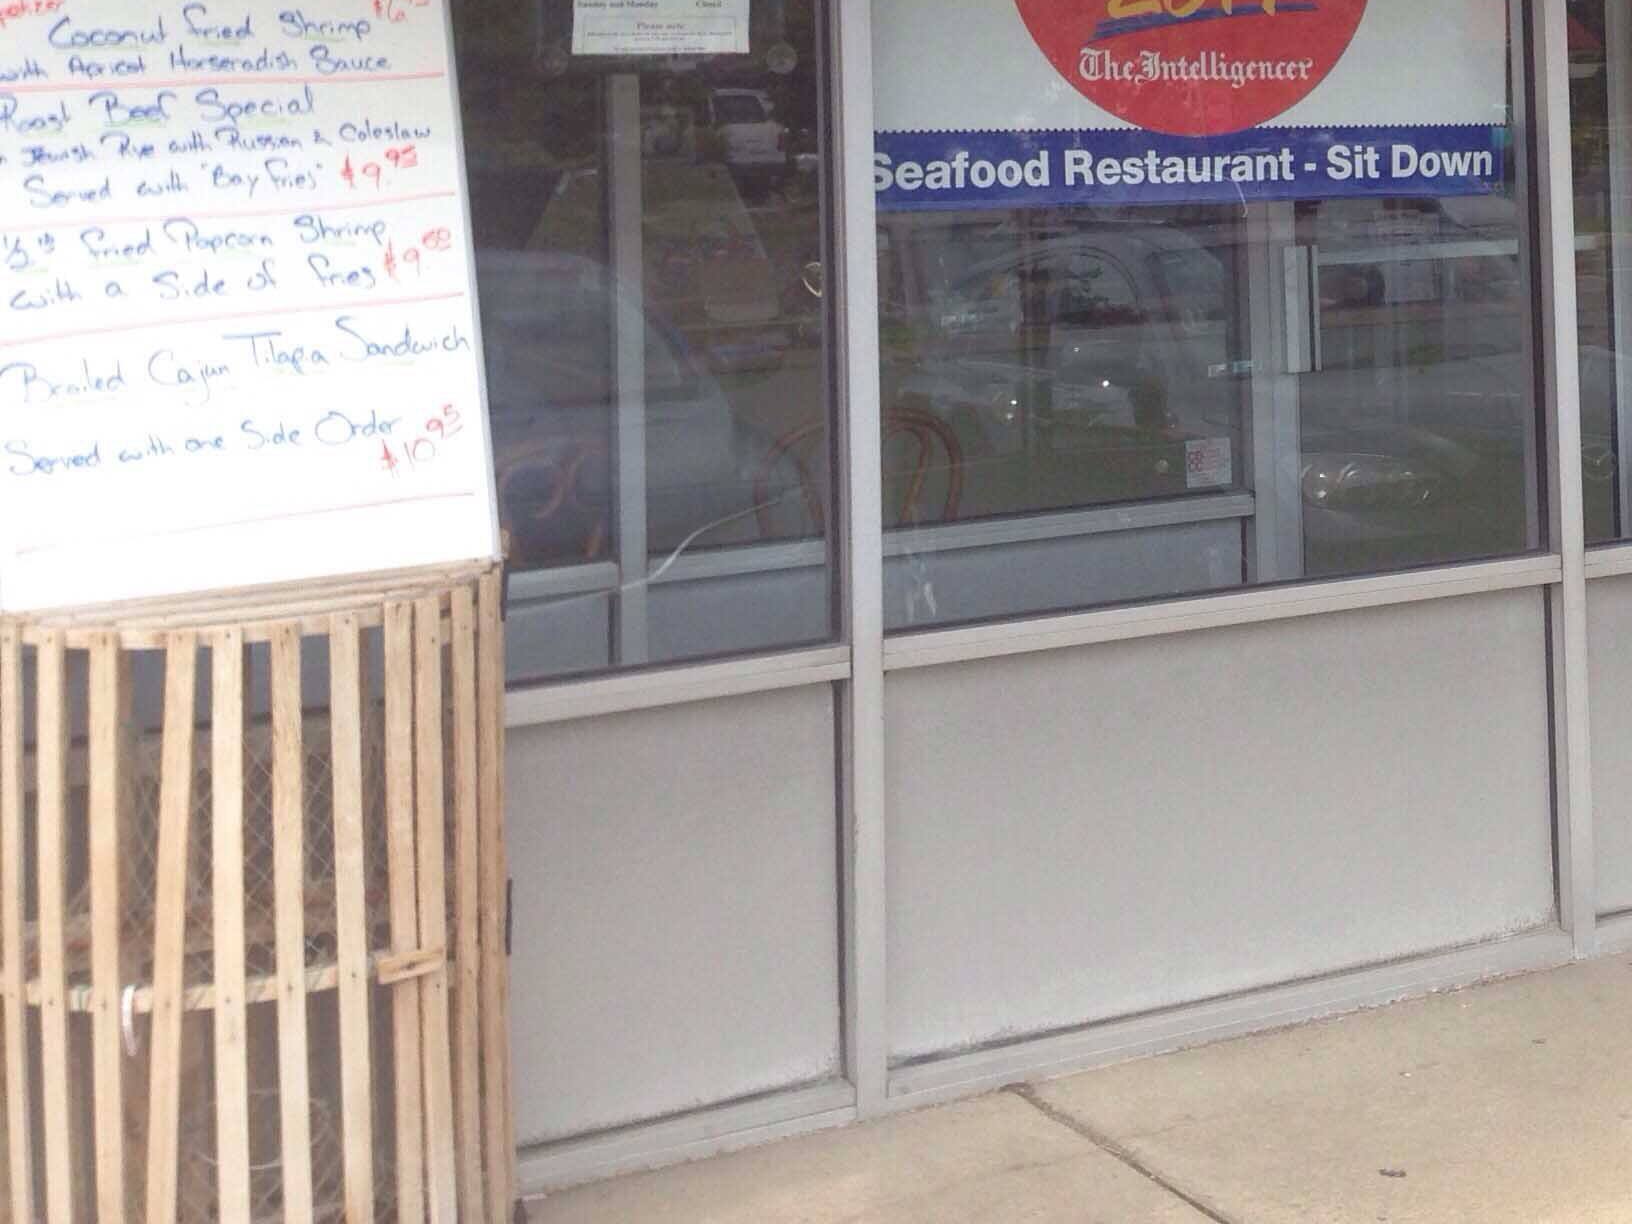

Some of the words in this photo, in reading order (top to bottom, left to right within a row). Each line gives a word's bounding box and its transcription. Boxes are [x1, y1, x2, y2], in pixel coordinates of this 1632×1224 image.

[48, 16, 168, 50] Coconut
[279, 9, 371, 41] Shrimp
[310, 44, 390, 75] Sauce
[1079, 47, 1136, 81] The
[1134, 49, 1313, 88] Intelligencer
[0, 93, 70, 134] Roast
[89, 91, 177, 122] Beef
[195, 86, 314, 124] Special
[100, 130, 155, 160] Rye
[169, 129, 212, 153] with
[215, 126, 303, 152] Russian
[339, 117, 431, 143] Coleslaw
[23, 174, 112, 208] Served
[137, 168, 188, 196] with
[874, 150, 1050, 191] Seafood
[1064, 149, 1295, 186] Restaurant
[1325, 144, 1379, 179] Sit
[1391, 144, 1493, 179] Down
[294, 215, 386, 246] Shrimp
[10, 276, 82, 310] with
[105, 281, 127, 298] a
[152, 268, 226, 300] Side
[247, 258, 277, 290] of
[148, 347, 230, 407] Cajun
[335, 316, 470, 362] Sandwich
[4, 438, 101, 476] Served
[119, 433, 174, 463] with
[184, 435, 224, 453] one
[240, 418, 302, 451] Side
[314, 409, 402, 446] Order
